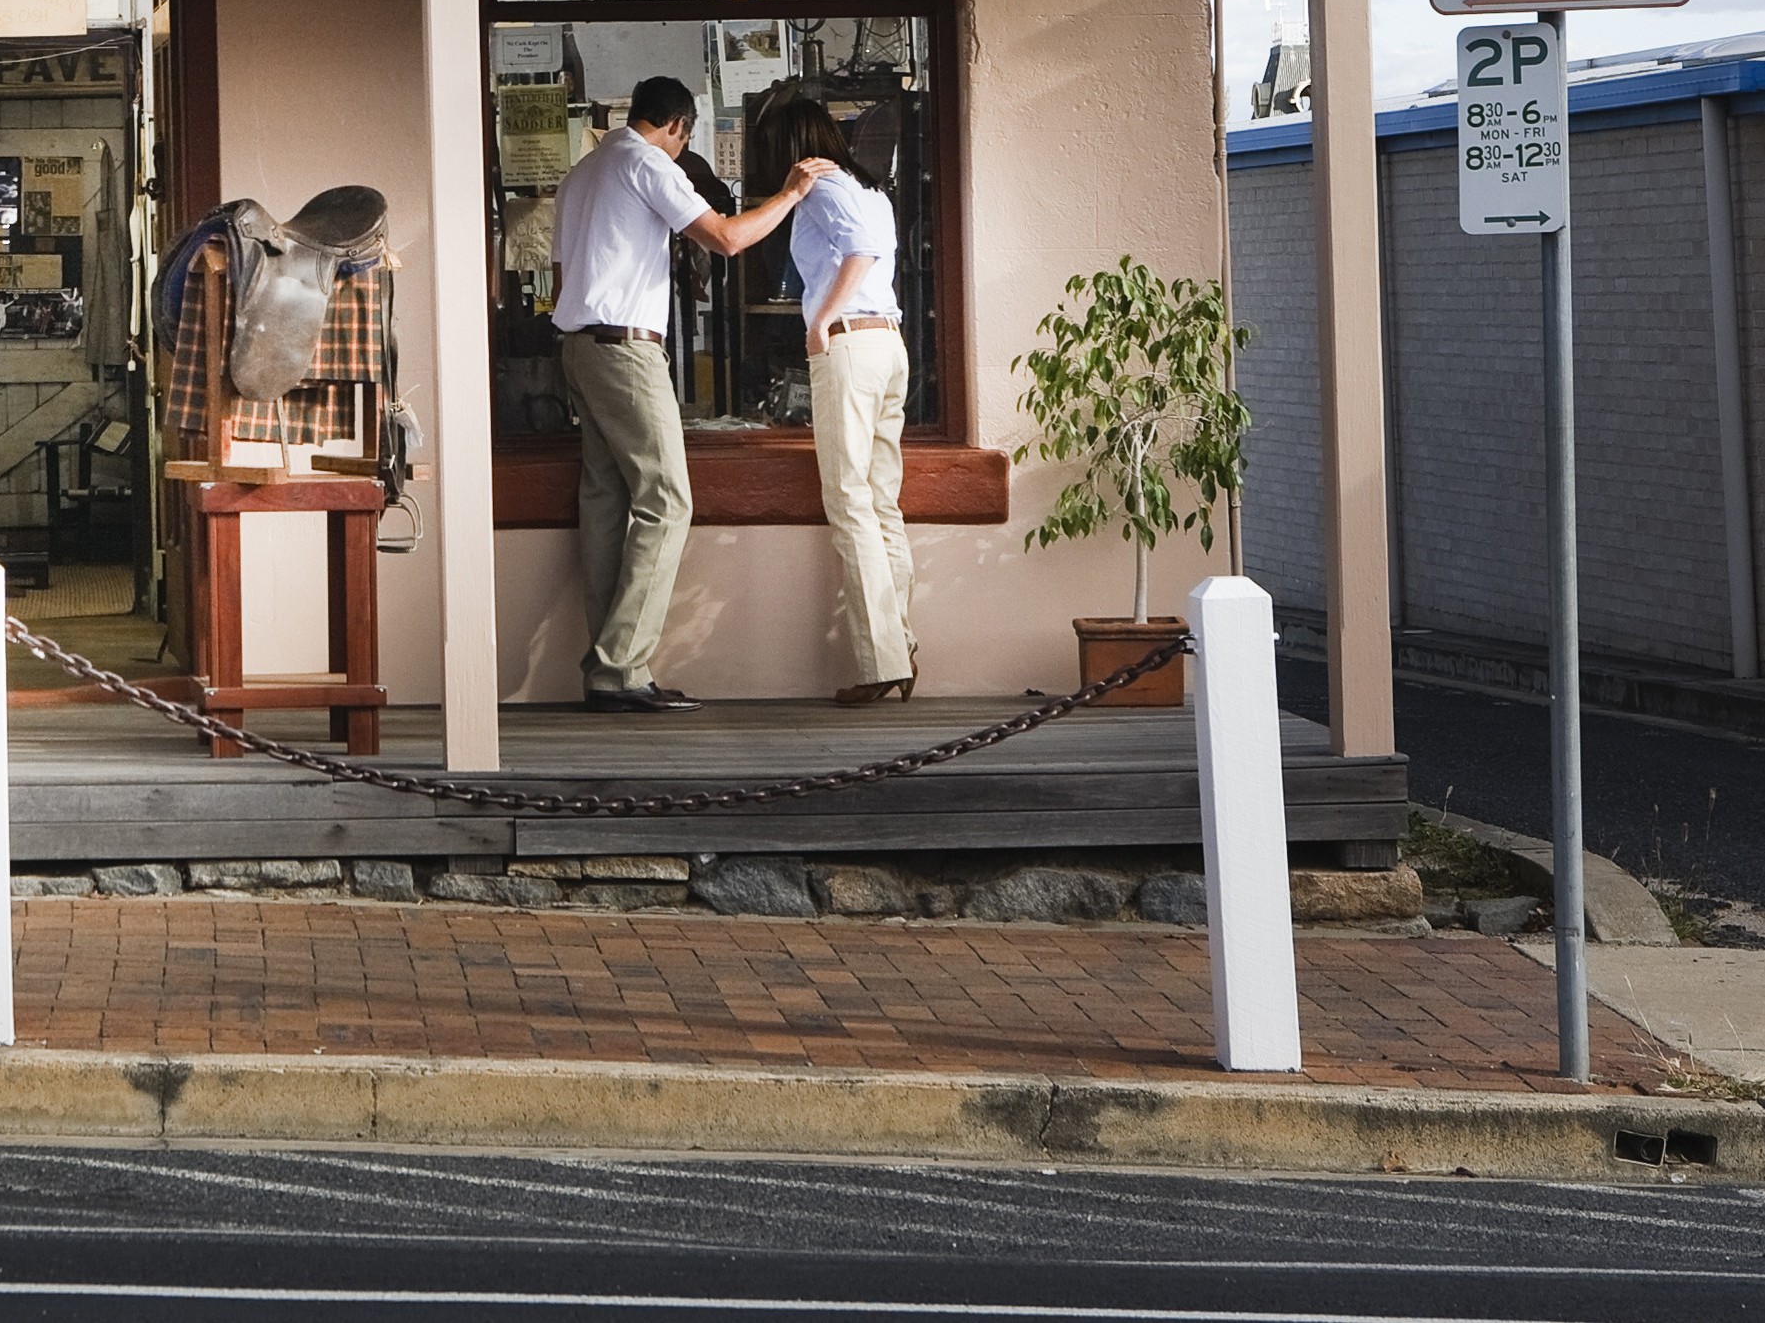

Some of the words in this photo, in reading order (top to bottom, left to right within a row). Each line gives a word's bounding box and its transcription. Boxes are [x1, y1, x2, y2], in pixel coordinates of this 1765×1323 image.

[1465, 35, 1549, 88] 2P
[502, 92, 566, 110] TENTERFIELD
[504, 116, 565, 132] SADDLER
[1486, 118, 1502, 127] AM
[1542, 114, 1558, 124] PM
[1479, 129, 1510, 141] MON
[1523, 127, 1546, 139] FRI
[35, 162, 65, 176] good
[1485, 161, 1501, 170] AM
[1544, 157, 1561, 167] PM
[1500, 171, 1529, 184] SAT
